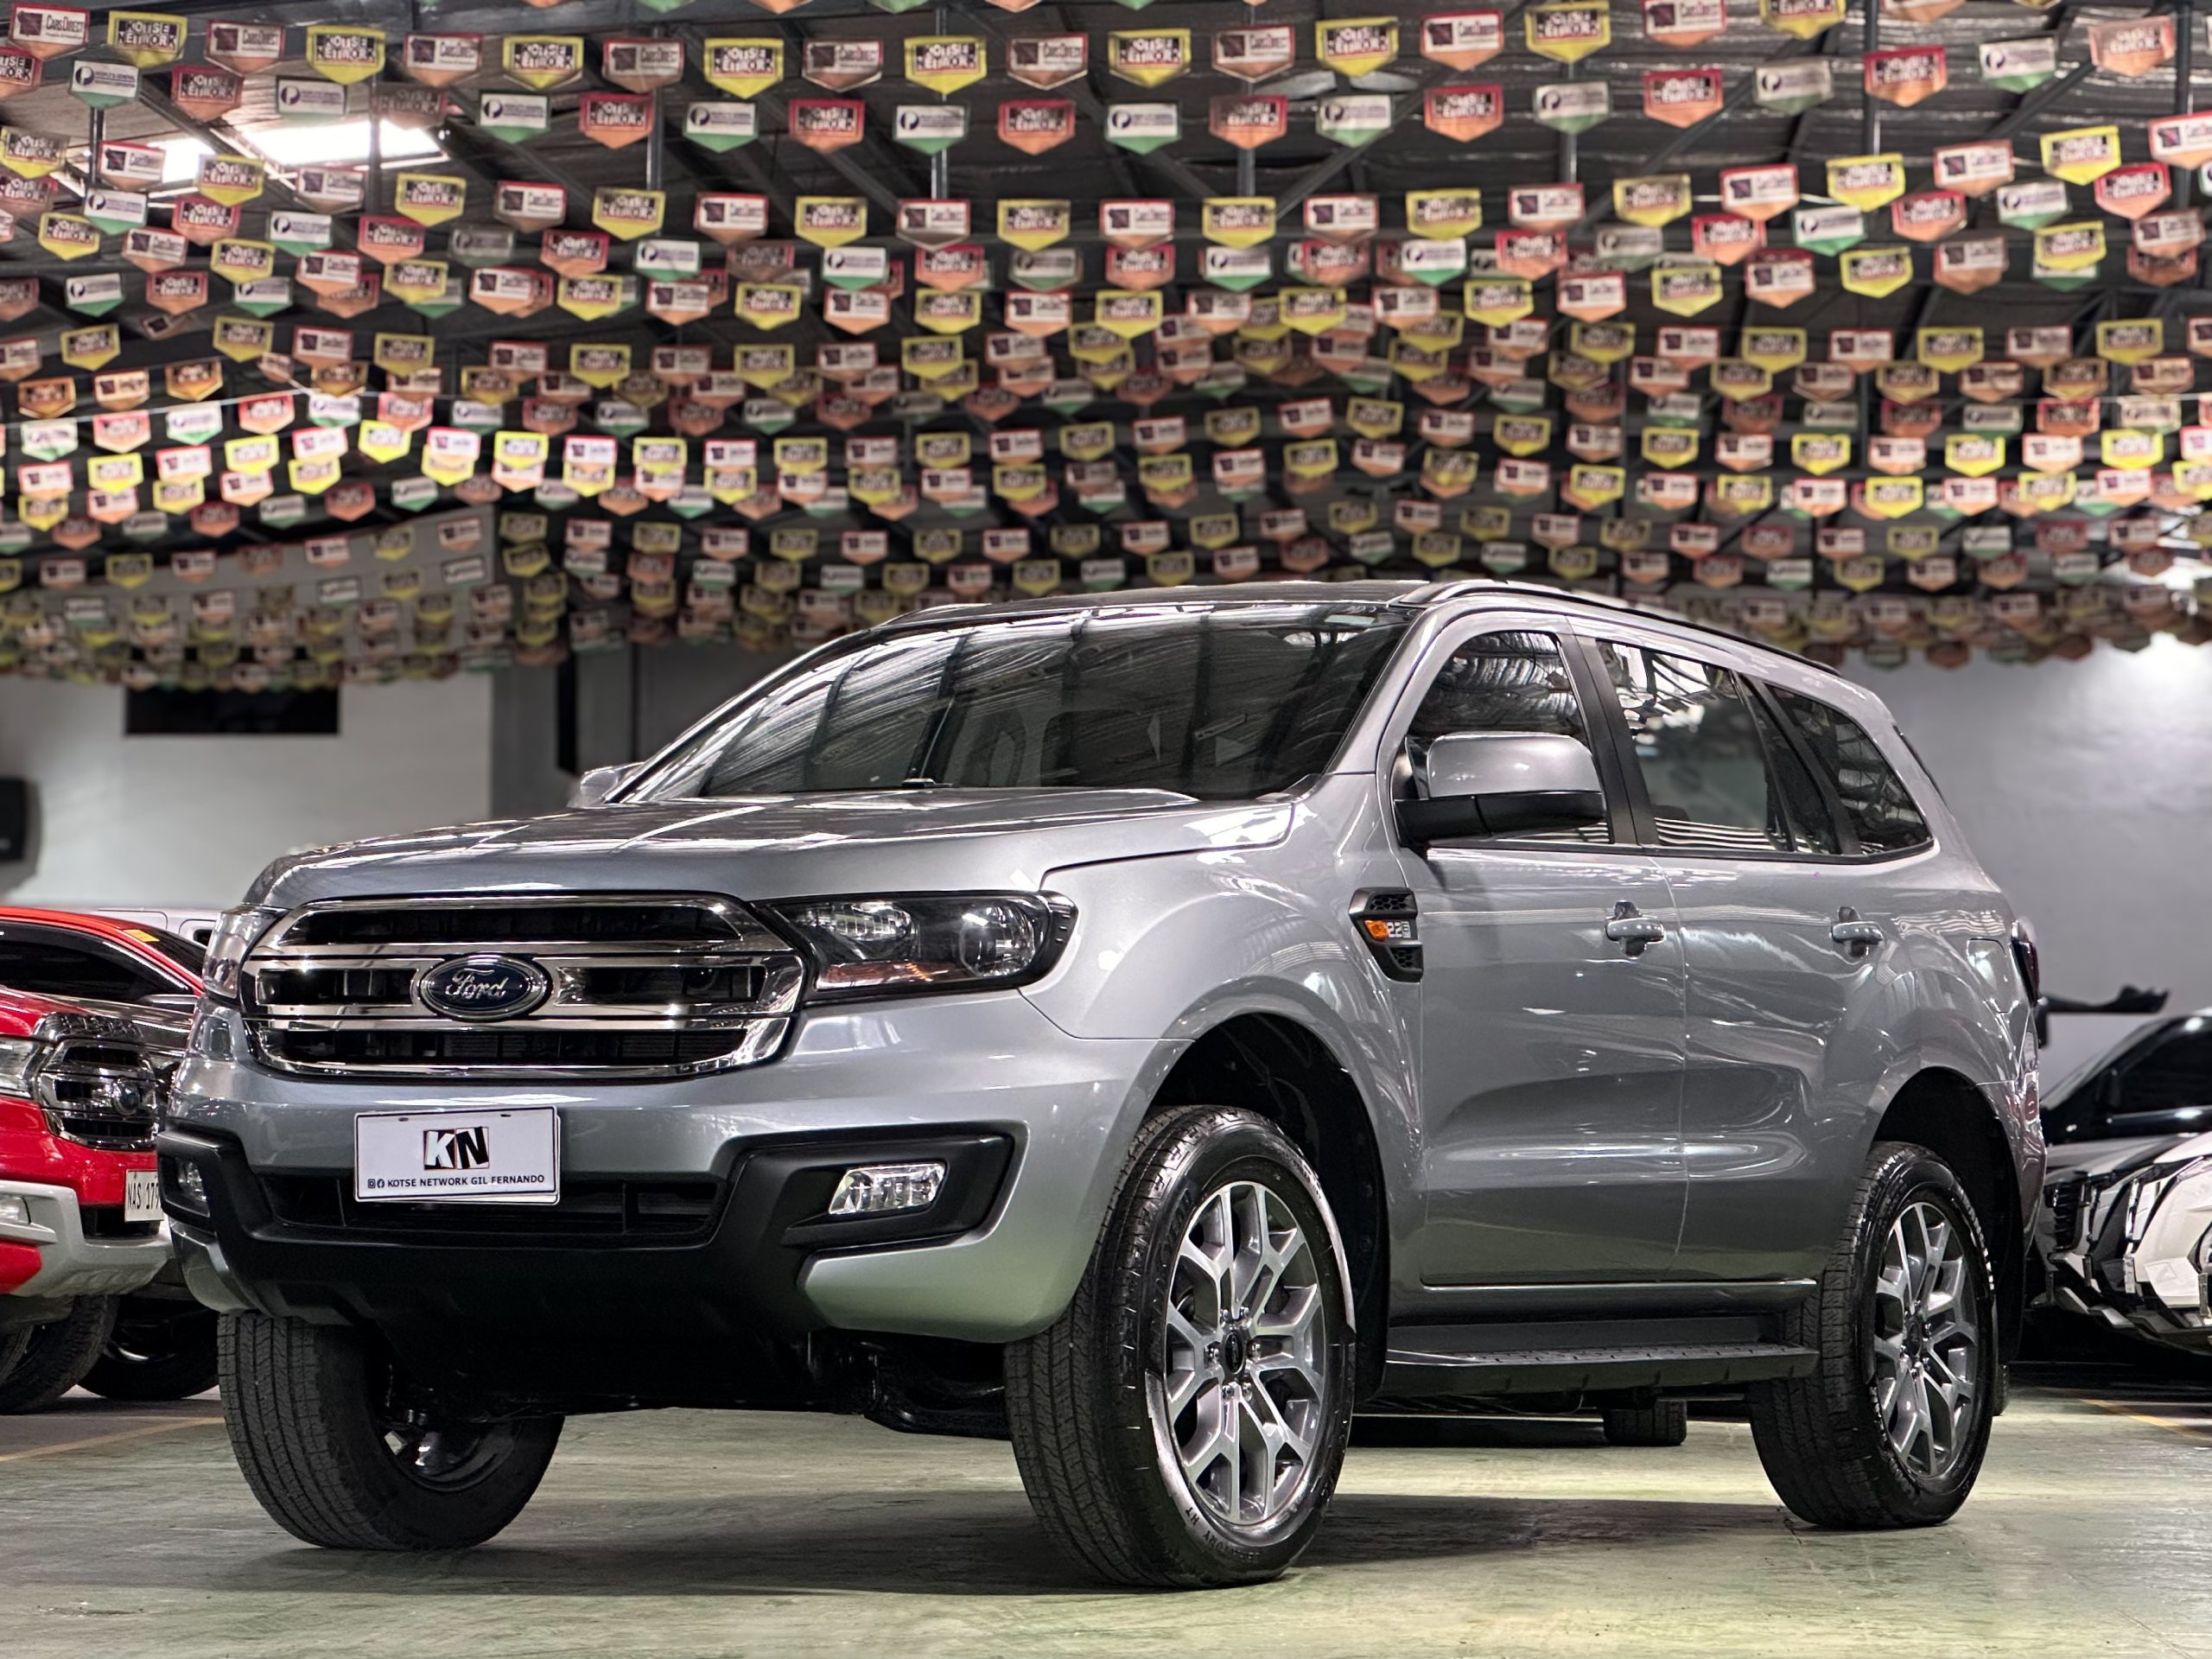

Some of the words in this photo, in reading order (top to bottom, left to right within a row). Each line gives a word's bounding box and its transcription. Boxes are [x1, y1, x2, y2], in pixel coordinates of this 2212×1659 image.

[445, 968, 509, 1000] Ford
[424, 1127, 489, 1170] KN
[388, 1179, 416, 1188] KOTSE
[420, 1177, 467, 1186] NETWORK
[471, 1176, 487, 1185] GIL
[491, 1174, 544, 1185] FERNANDO
